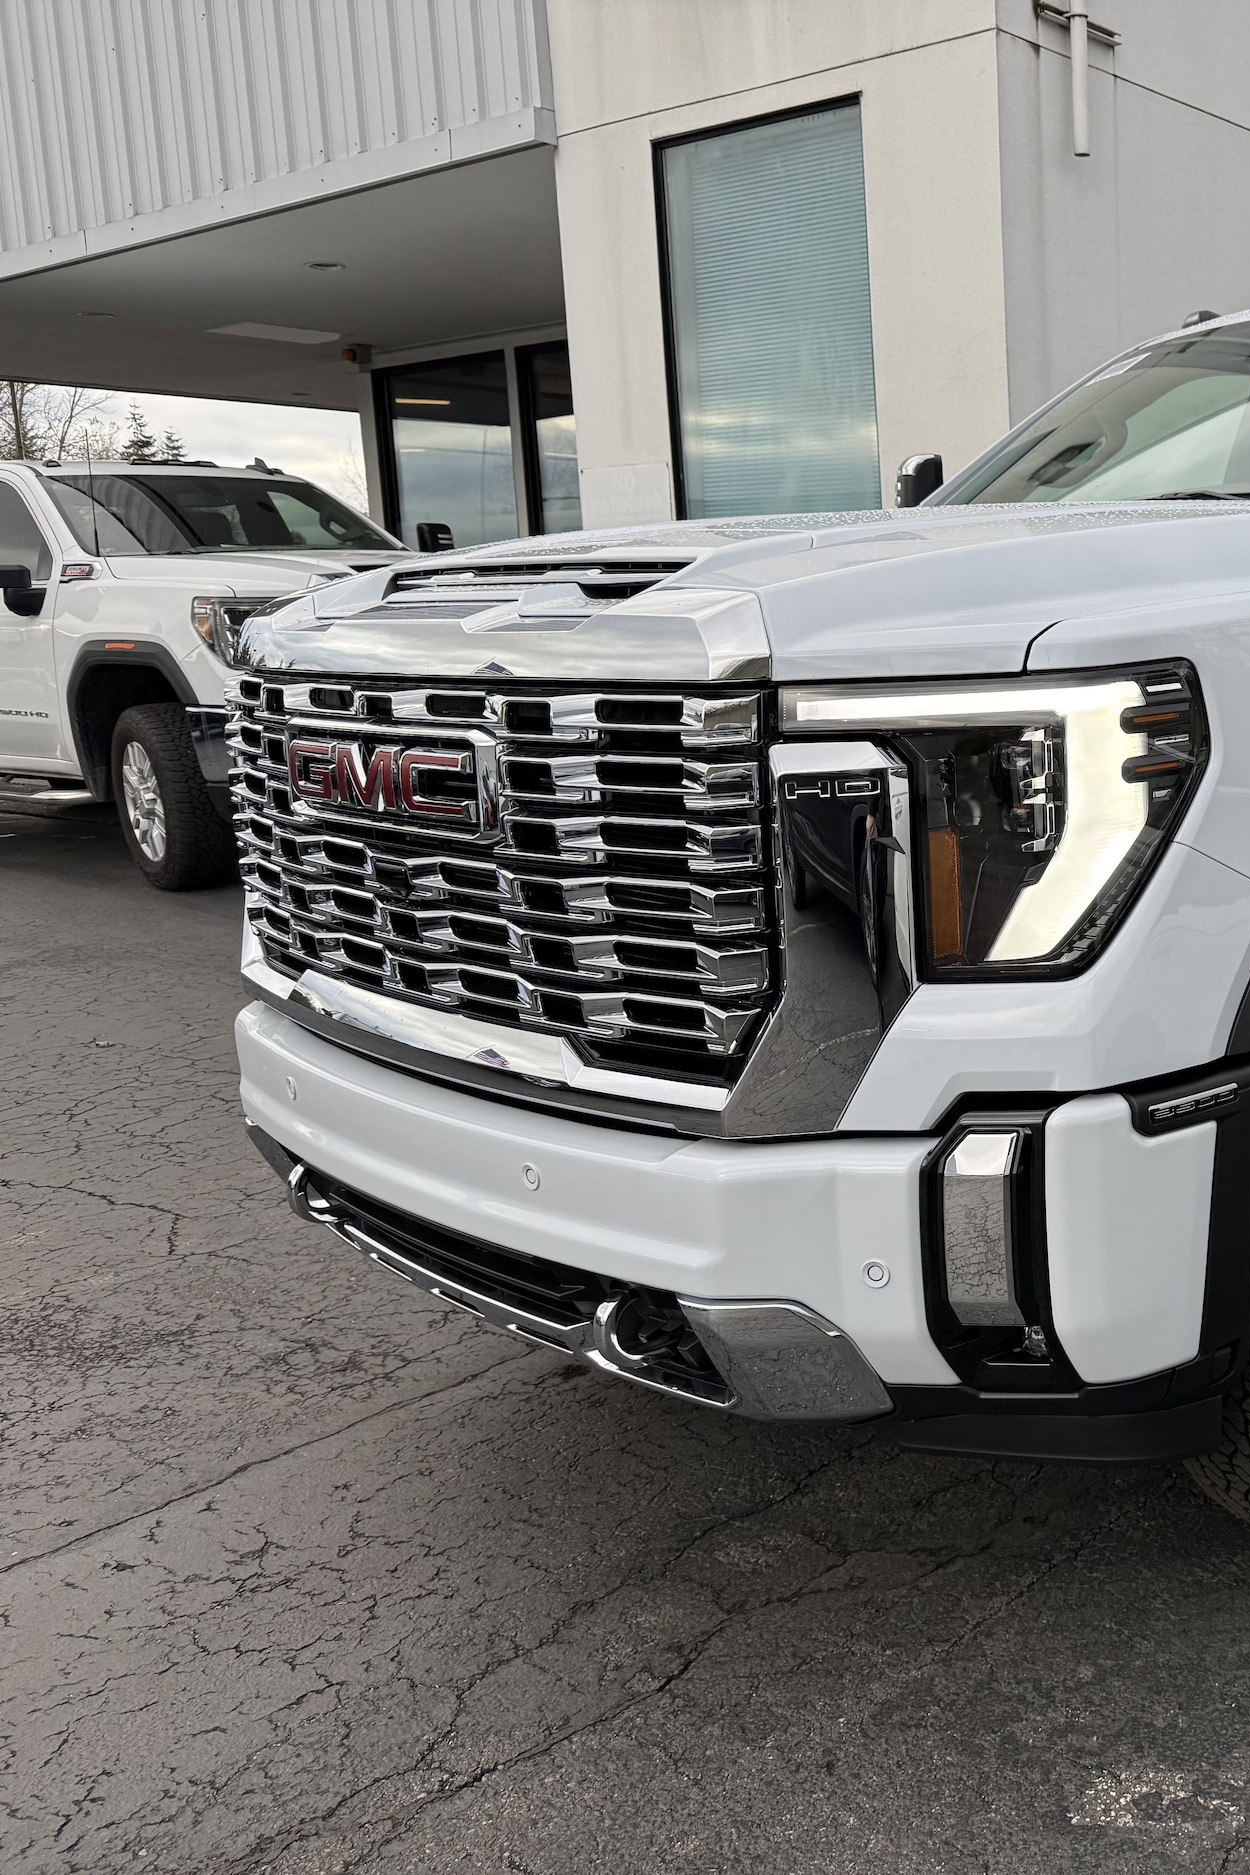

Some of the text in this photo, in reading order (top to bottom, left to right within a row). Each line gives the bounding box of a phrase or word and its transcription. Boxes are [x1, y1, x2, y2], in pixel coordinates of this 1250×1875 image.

[29, 710, 49, 719] HD
[289, 739, 478, 822] GMC
[784, 778, 881, 800] HD
